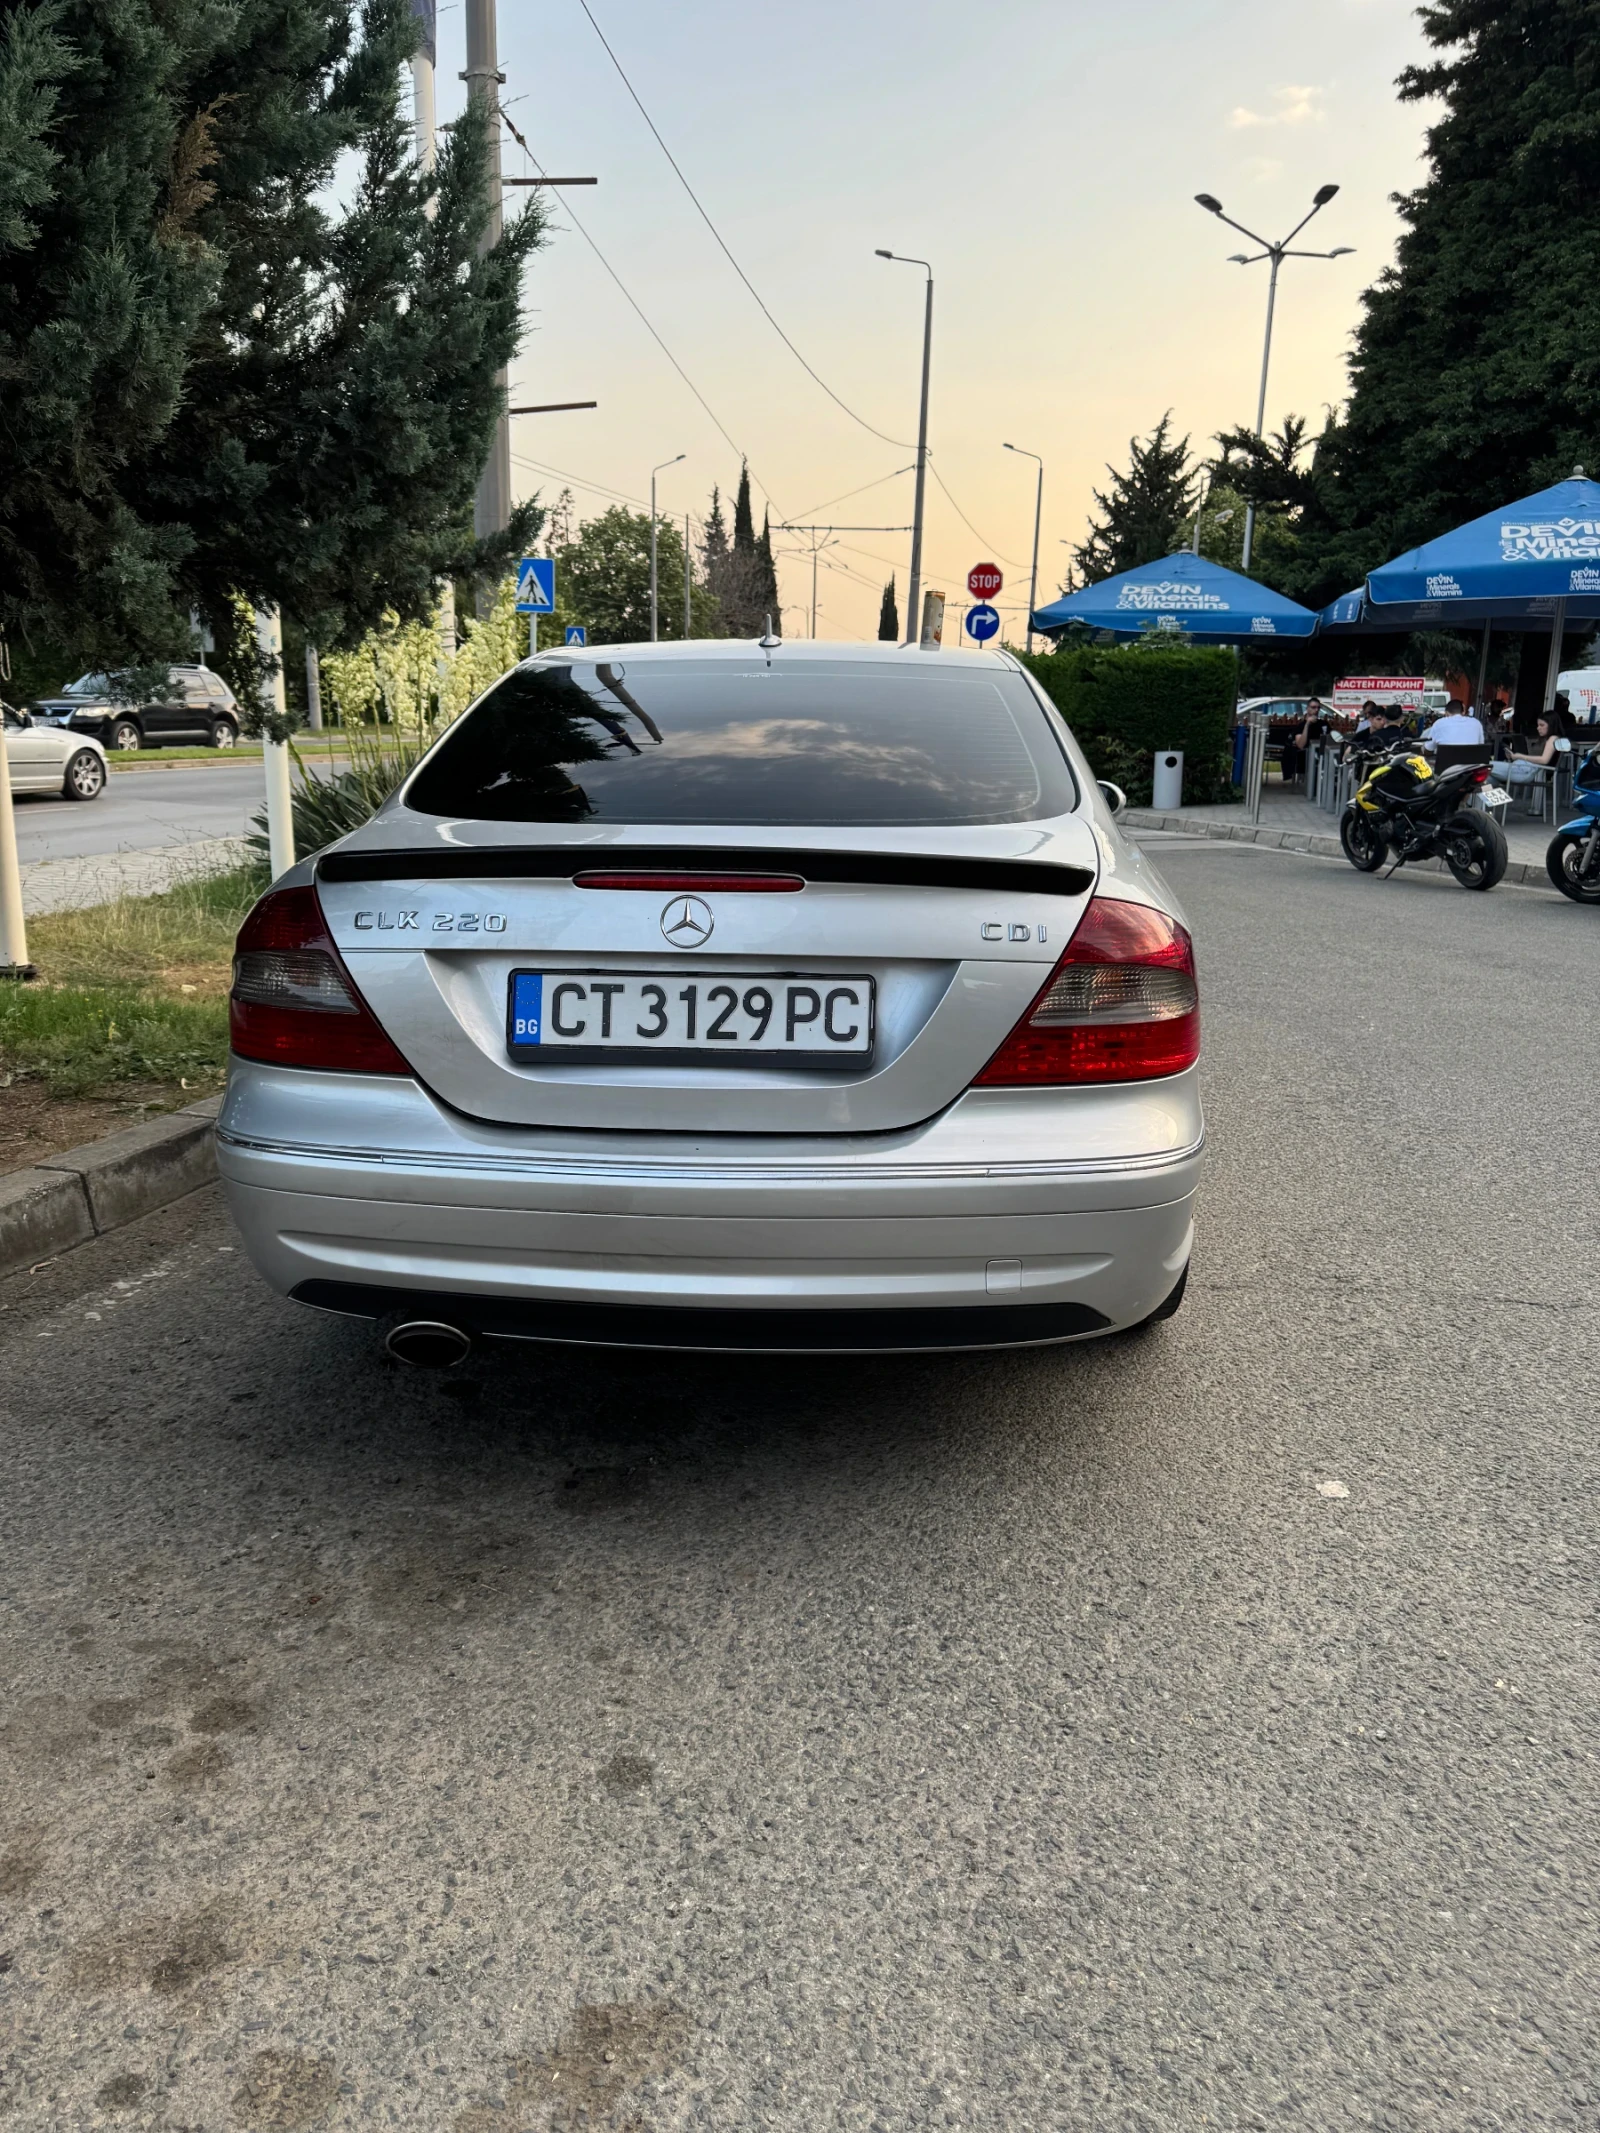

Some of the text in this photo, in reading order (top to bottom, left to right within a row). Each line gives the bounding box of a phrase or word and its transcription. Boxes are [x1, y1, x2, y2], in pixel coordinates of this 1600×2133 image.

[1571, 569, 1599, 578] DEVIN
[970, 574, 1000, 589] STOP
[1426, 576, 1454, 585] DEVIN
[1121, 584, 1202, 595] DEVIN
[1429, 583, 1460, 591] Minerals
[1127, 594, 1220, 602] Minerals
[1337, 680, 1422, 689] ЧАСТЕН ПАРКИНГ
[354, 911, 507, 932] CLK 220
[981, 922, 1047, 943] CDI
[515, 1018, 538, 1035] BG
